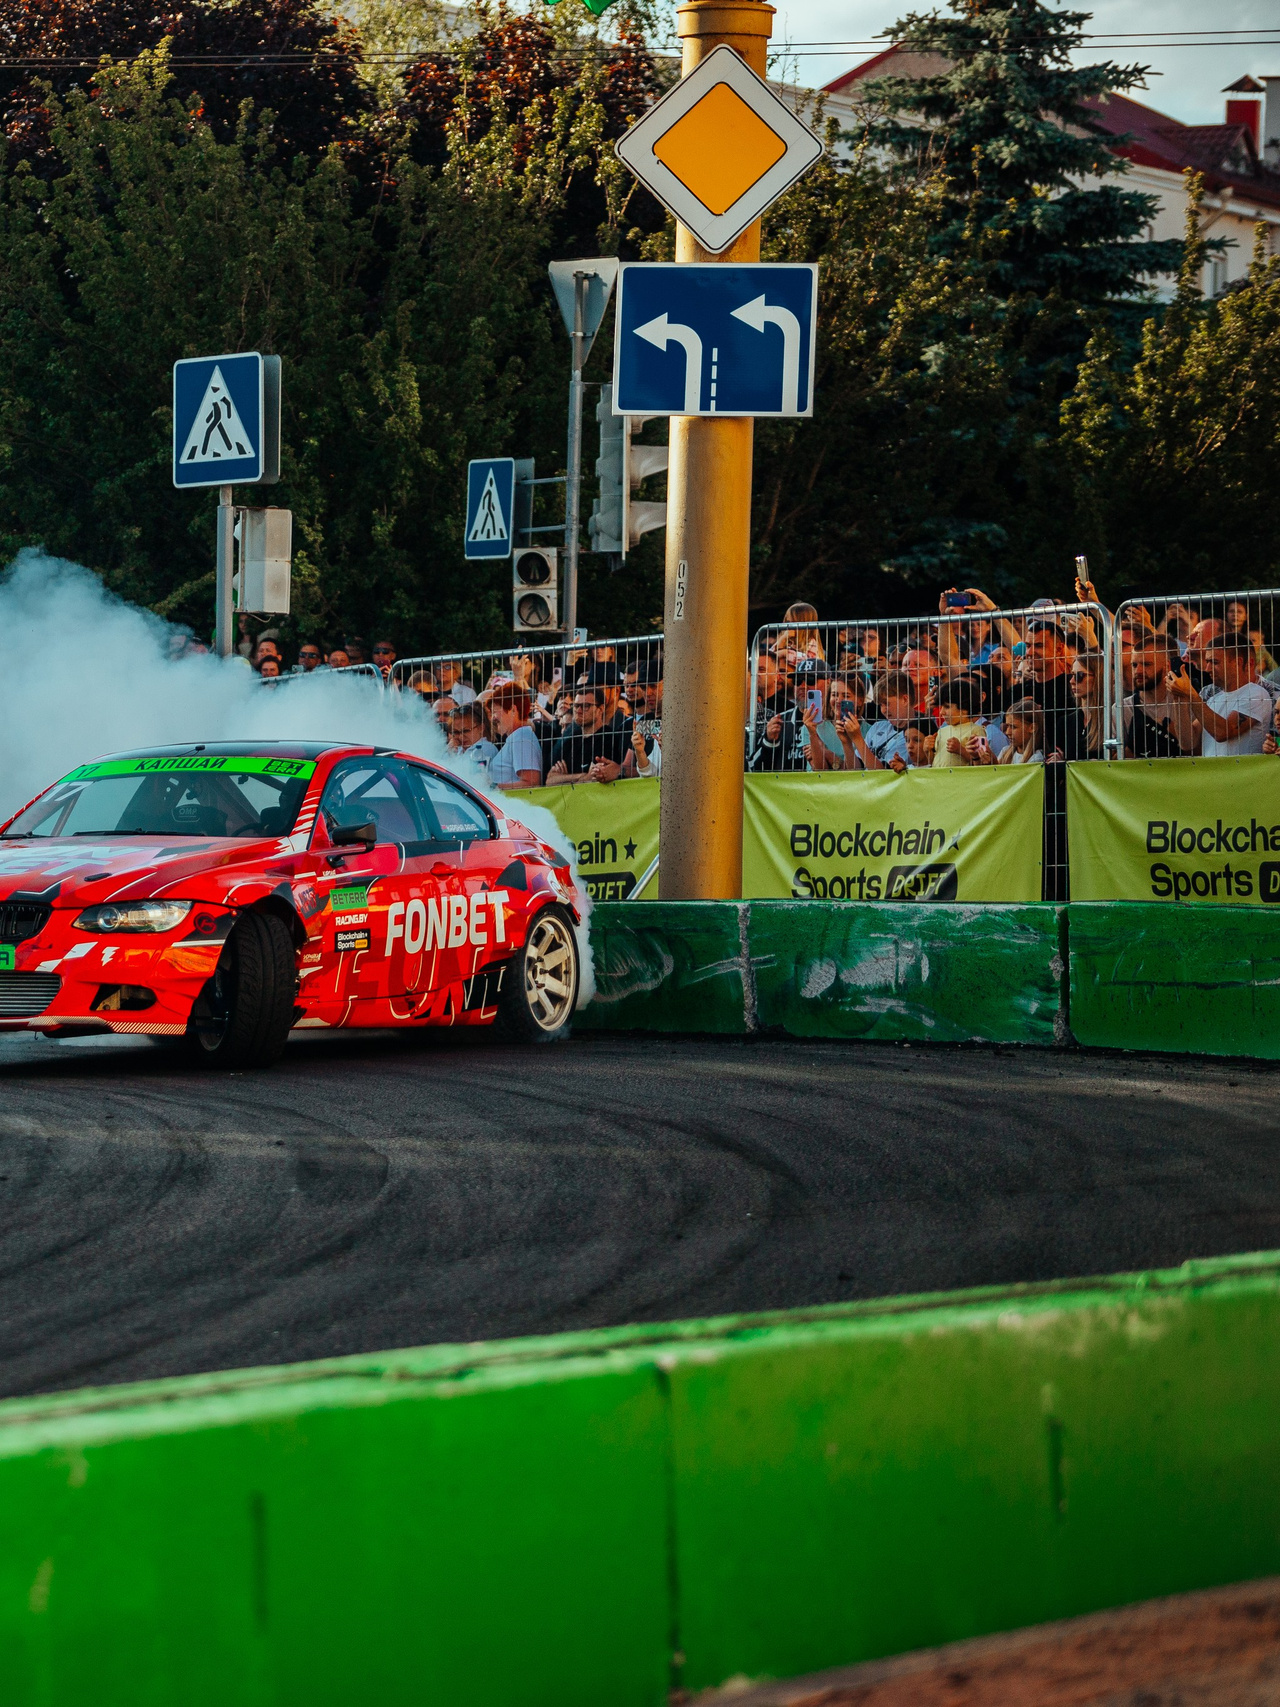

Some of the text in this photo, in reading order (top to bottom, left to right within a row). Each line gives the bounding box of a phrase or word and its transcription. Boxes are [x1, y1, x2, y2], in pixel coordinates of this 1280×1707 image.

[790, 821, 947, 858] Blockchain
[791, 866, 949, 899] Sports DRIFT
[1150, 862, 1253, 900] Sports
[384, 890, 510, 957] FONBET
